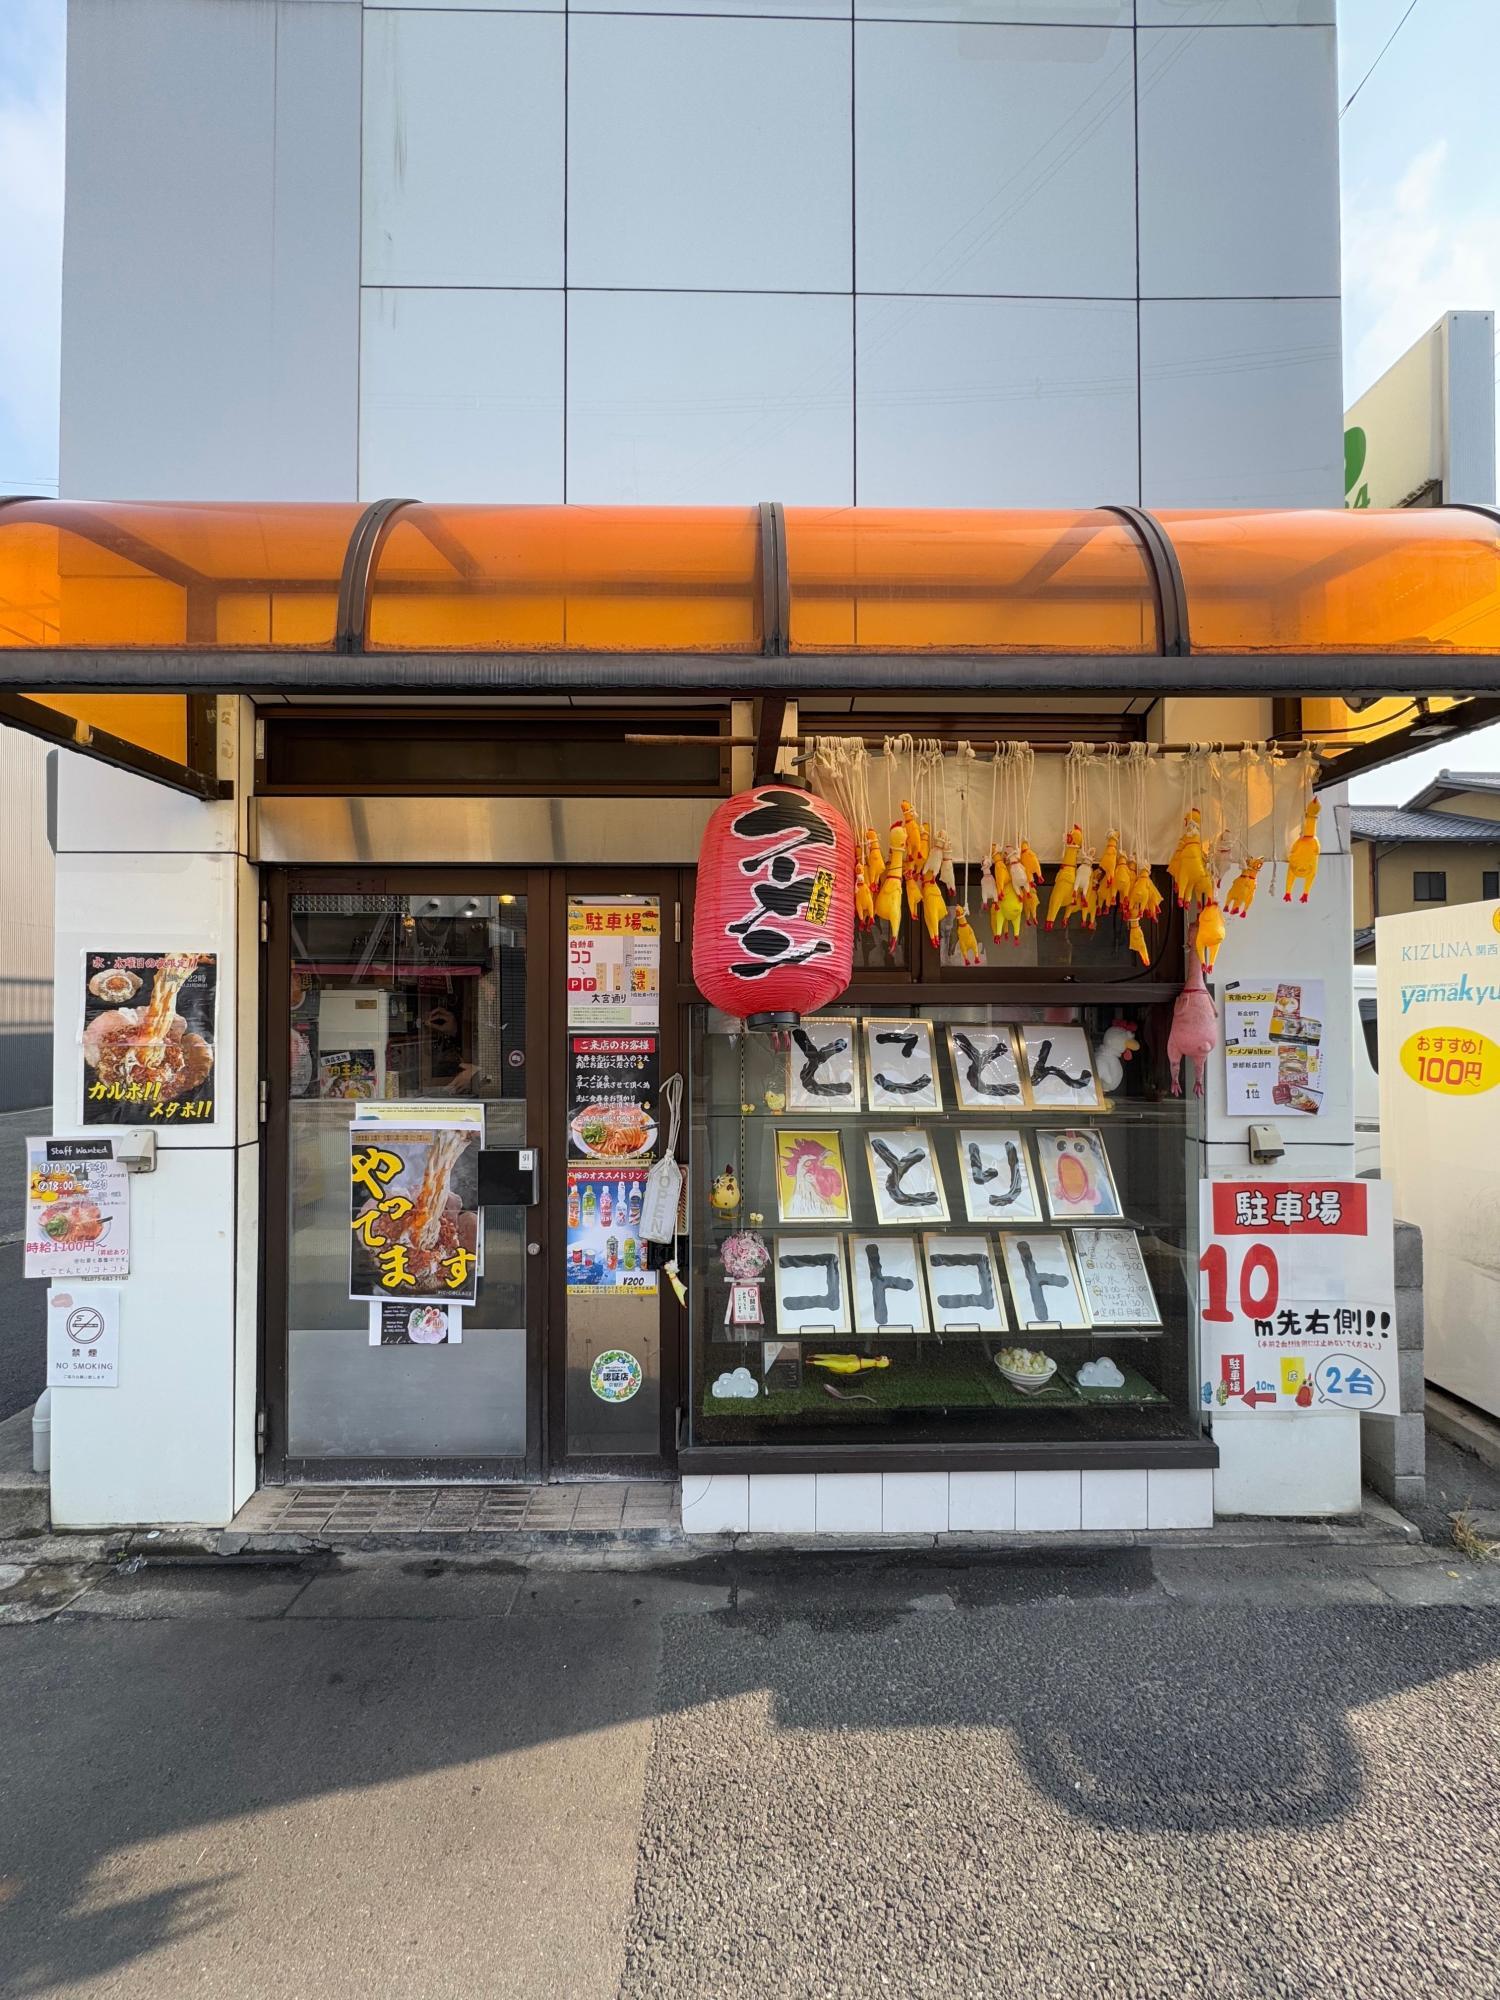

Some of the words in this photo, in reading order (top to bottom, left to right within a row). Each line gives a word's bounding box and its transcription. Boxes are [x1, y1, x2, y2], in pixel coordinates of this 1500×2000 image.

[585, 912, 642, 931] 駐車場
[570, 950, 591, 964] ココ
[1401, 941, 1472, 962] KIZUNA
[591, 993, 627, 1004] 大宮通り
[1243, 1028, 1257, 1038] 1位
[579, 1040, 650, 1051] ご来店のお客様
[1417, 1035, 1484, 1056] おすすめ!
[88, 1081, 162, 1100] カルボ!!
[1245, 1089, 1260, 1099] 1位
[50, 1146, 73, 1155] Staff
[76, 1146, 108, 1154] Wanted
[871, 1138, 1023, 1207] とり
[650, 1175, 671, 1234] OPEN
[1234, 1190, 1342, 1227] 駐車場
[622, 1277, 645, 1286] ¥200
[779, 1241, 1070, 1325] コトコト
[1199, 1243, 1280, 1323] 10
[56, 1362, 69, 1370] NO
[73, 1362, 113, 1370] SMOKING
[1229, 1357, 1241, 1392] 駐車場
[1255, 1380, 1276, 1391] 10m
[1326, 1366, 1375, 1396] 2台
